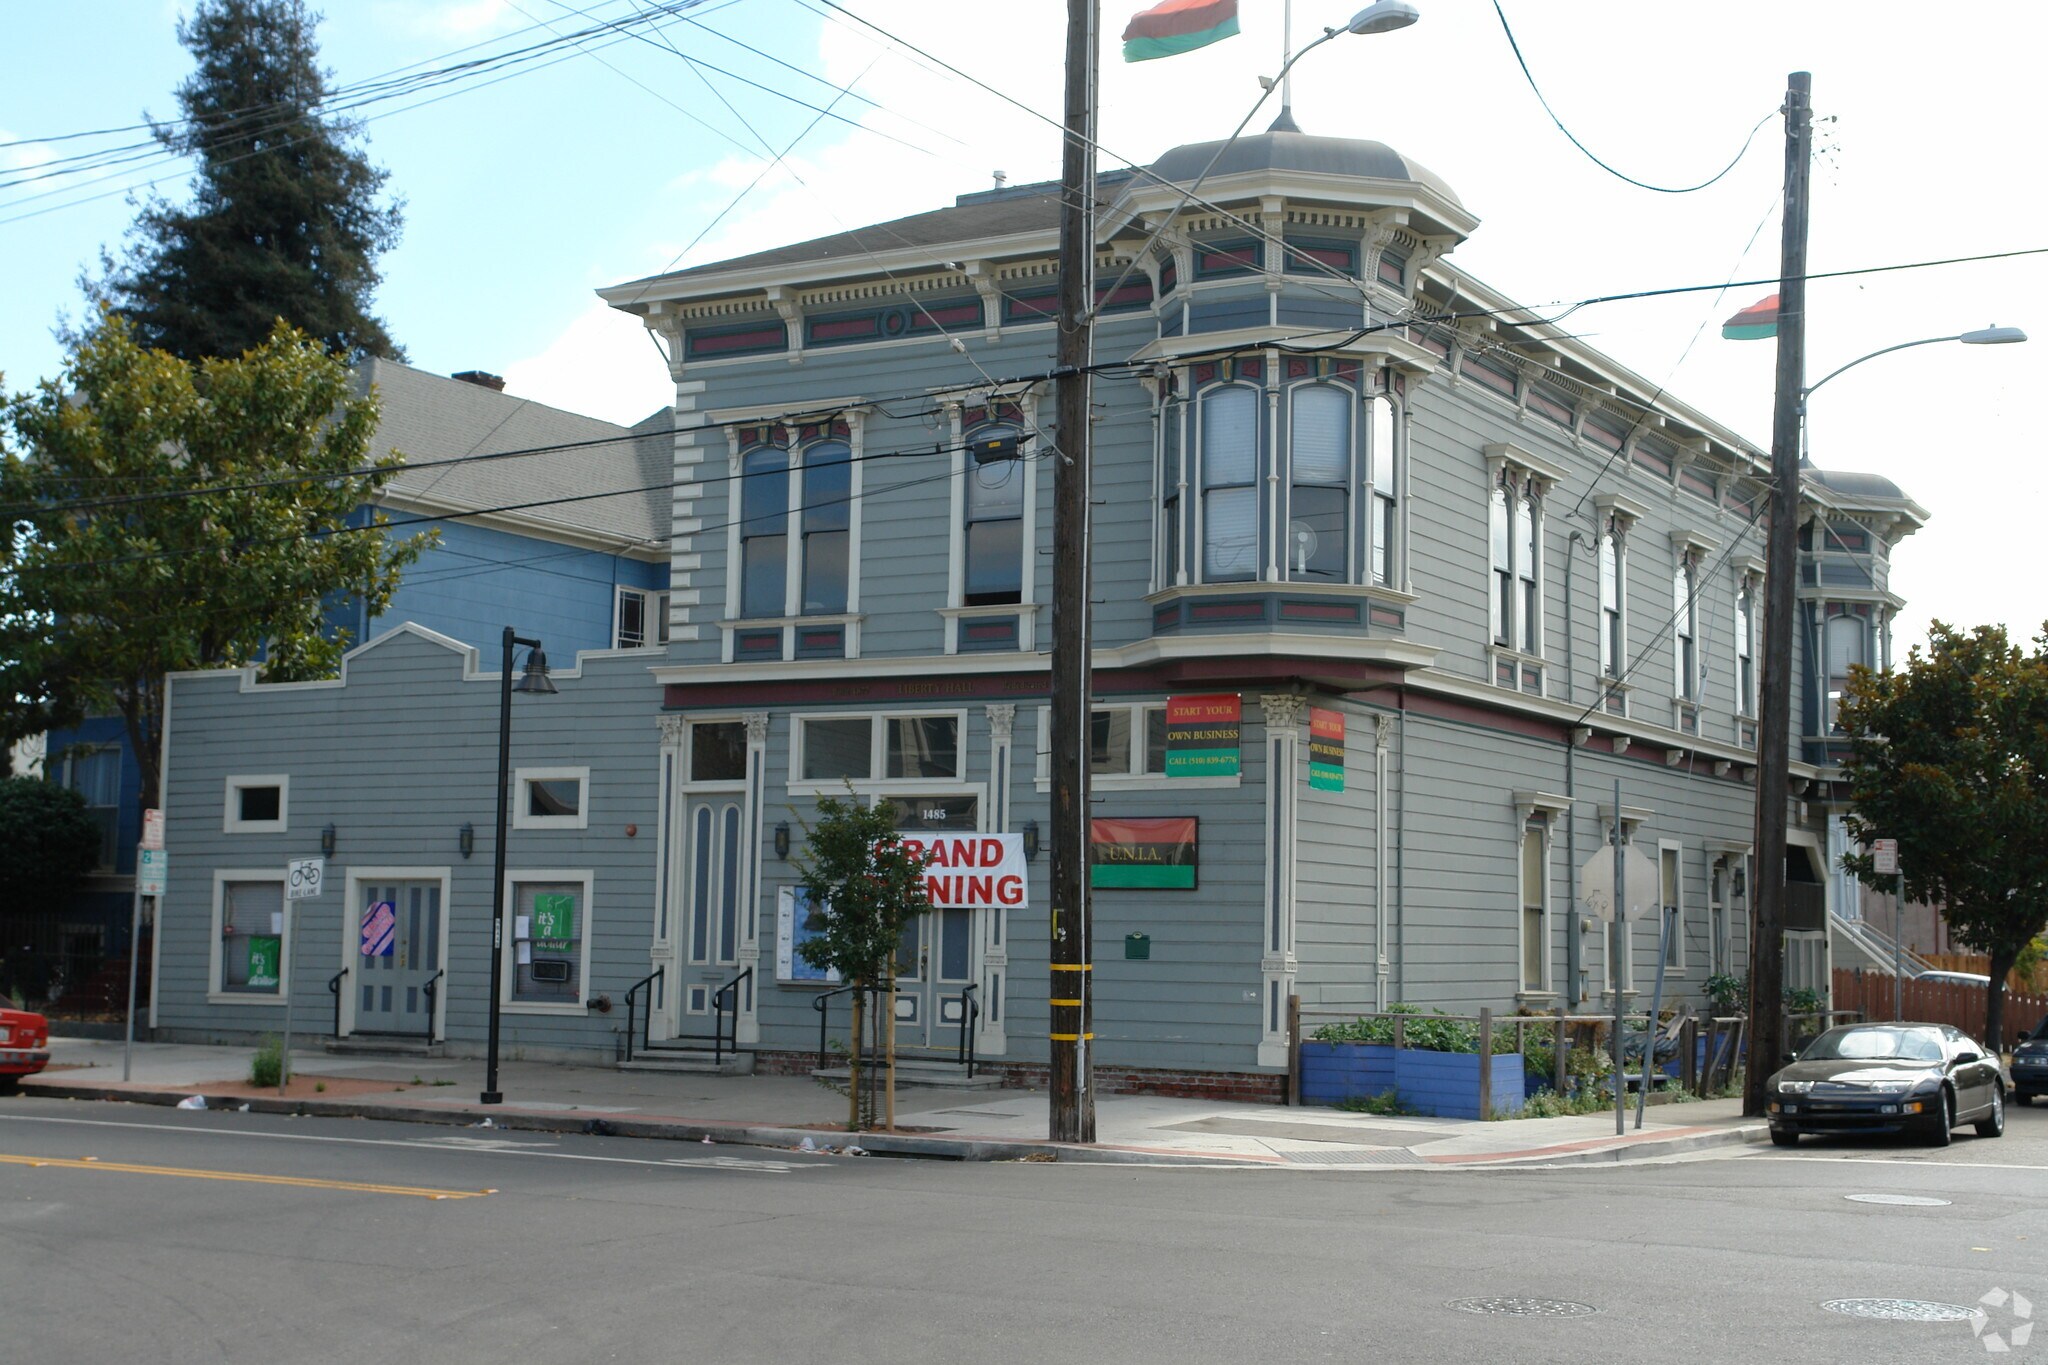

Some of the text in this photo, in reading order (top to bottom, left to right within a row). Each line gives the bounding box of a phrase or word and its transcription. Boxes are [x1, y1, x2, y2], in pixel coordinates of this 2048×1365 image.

[898, 681, 975, 694] LIBERTY HALL
[1173, 705, 1233, 717] START YOUR
[1167, 729, 1239, 741] OWN BUSINESS
[1310, 743, 1323, 753] OWN
[1168, 757, 1187, 766] CALL
[1189, 756, 1205, 766] (510)
[923, 809, 946, 820] 1485
[1110, 847, 1162, 860] U.N.I.A.
[538, 911, 555, 925] it's
[543, 926, 552, 936] a
